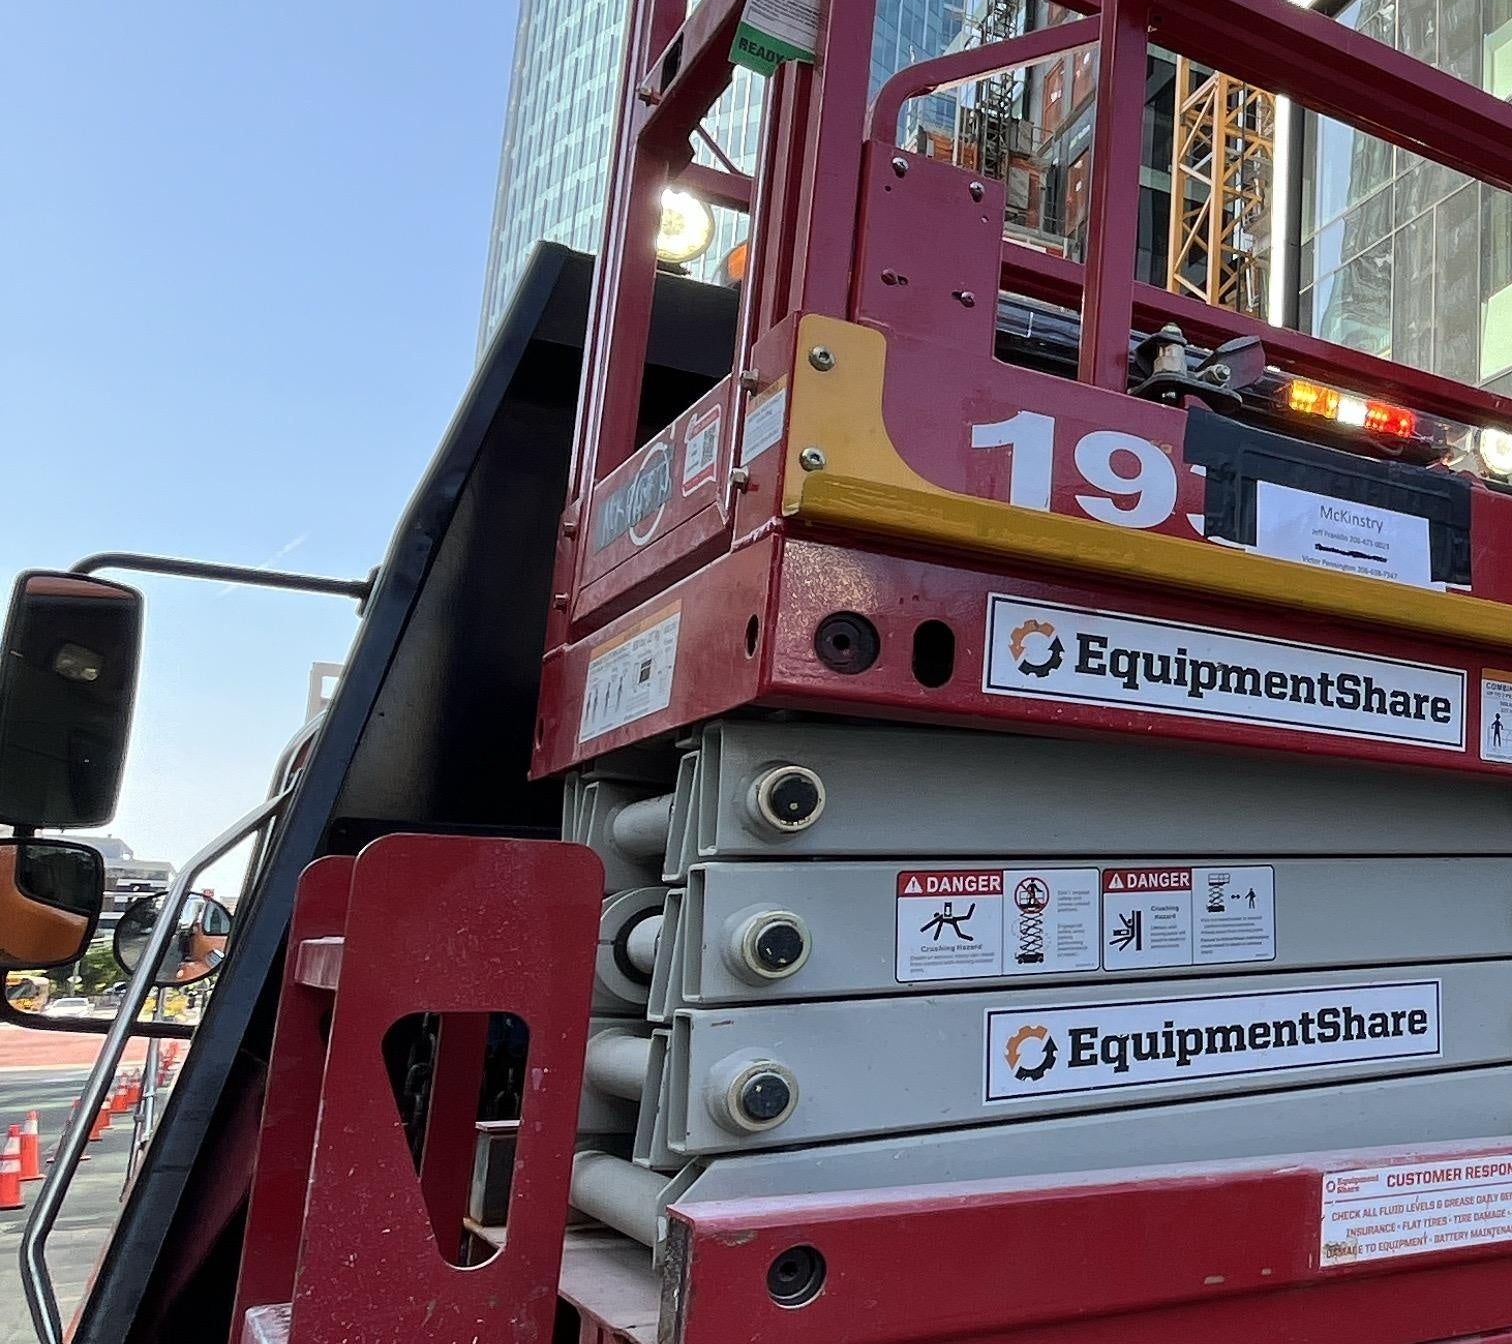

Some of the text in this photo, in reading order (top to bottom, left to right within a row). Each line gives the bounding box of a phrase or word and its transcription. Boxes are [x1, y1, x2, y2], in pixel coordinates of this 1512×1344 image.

[738, 37, 785, 64] READY
[1319, 504, 1384, 535] McKinstry
[1074, 633, 1452, 724] EquipmentShare
[926, 875, 1001, 894] DANGER
[1127, 872, 1190, 889] DANGER
[1067, 1002, 1428, 1074] EquipmentShare
[1386, 1169, 1462, 1188] CUSTOMER
[1331, 1208, 1361, 1222] CHECK
[1363, 1207, 1378, 1219] ALL
[1379, 1203, 1405, 1217] FLUID
[1406, 1200, 1435, 1214] LEVELS
[1444, 1196, 1475, 1210] GREASE
[1476, 1193, 1499, 1205] DAILY
[1346, 1222, 1396, 1238] INSURANCE
[1402, 1219, 1422, 1230] FLAT
[1423, 1216, 1448, 1228] TIRES
[1454, 1213, 1472, 1225] TIRE
[1473, 1209, 1506, 1222] DAMAGE
[1365, 1242, 1377, 1253] TO
[1379, 1237, 1428, 1252] EQUIPMENT
[1434, 1230, 1469, 1244] BATTERY
